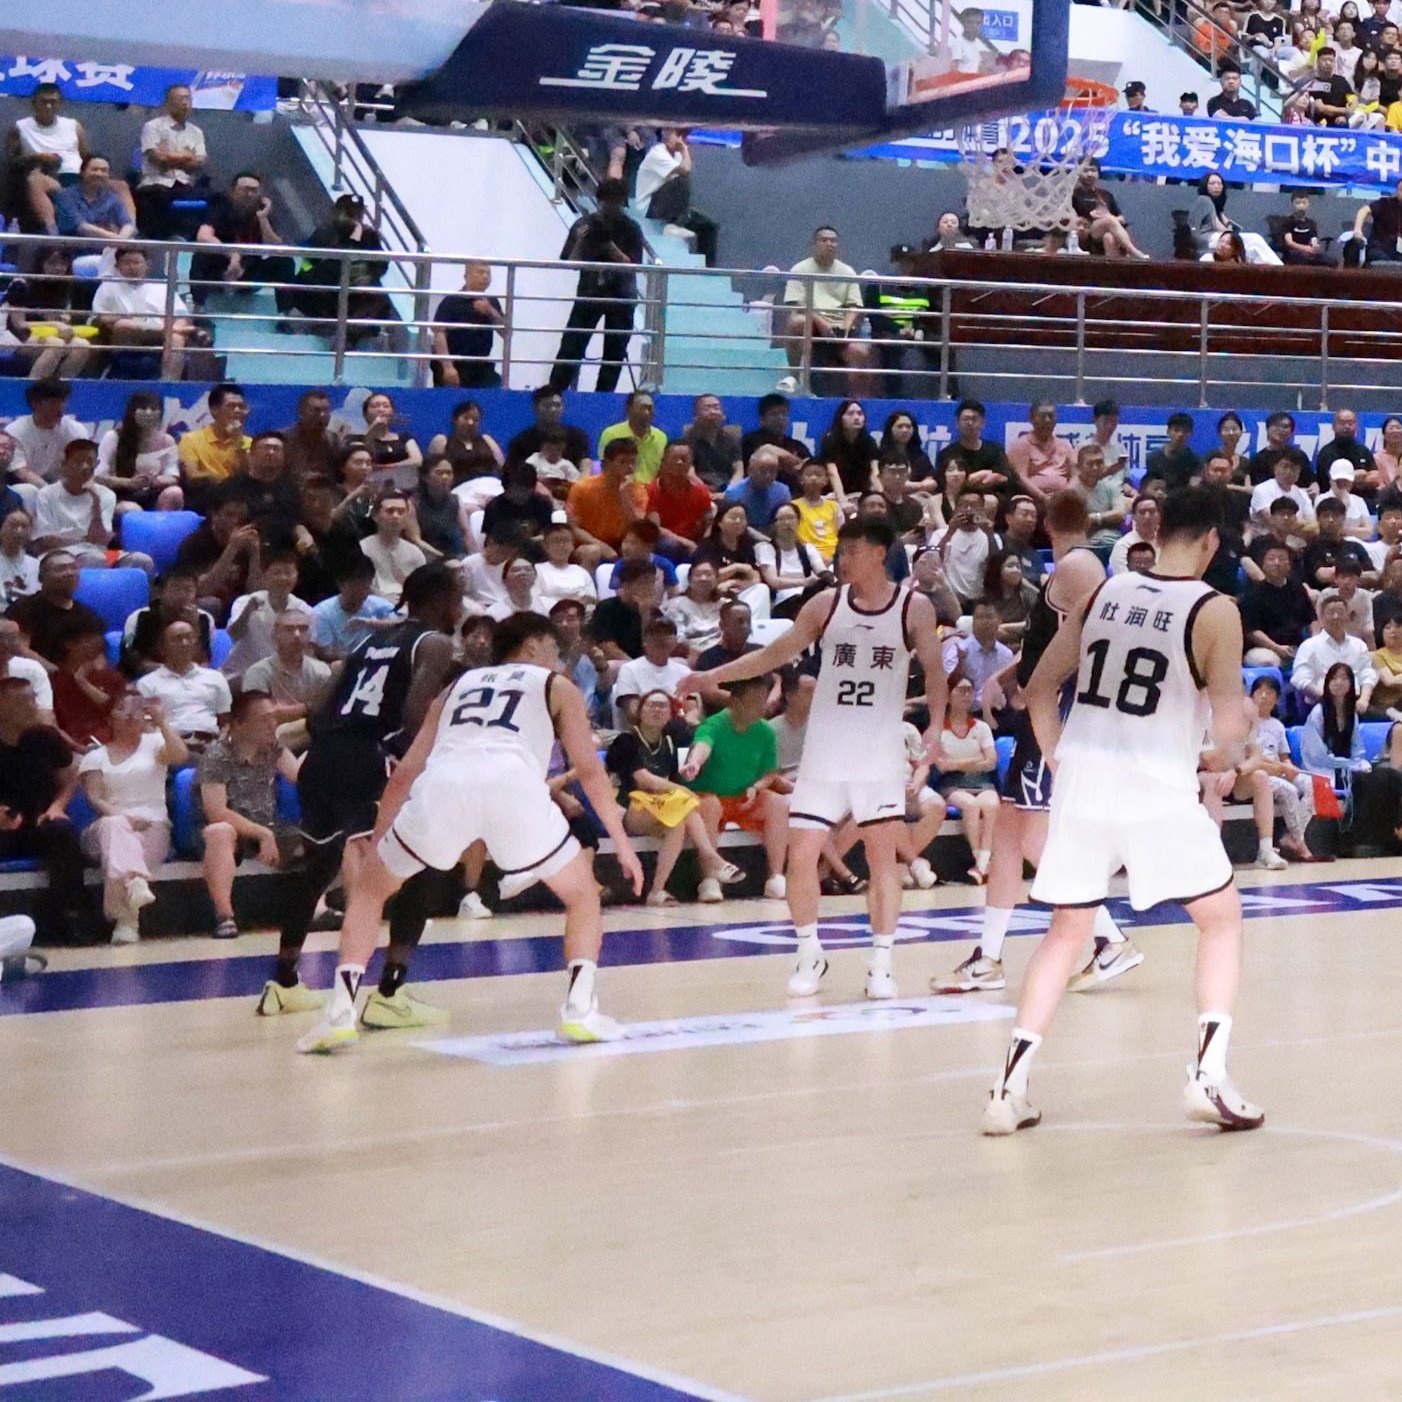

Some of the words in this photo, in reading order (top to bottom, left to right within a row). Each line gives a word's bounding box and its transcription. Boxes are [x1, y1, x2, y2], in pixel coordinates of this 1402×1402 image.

[566, 42, 750, 97] 金陵
[1122, 119, 1357, 178] “我爱海口杯”
[1099, 601, 1176, 634] 杜润旺
[831, 641, 897, 671] 廣東
[1076, 637, 1170, 718] 18
[449, 686, 526, 734] 21
[836, 679, 877, 708] 22
